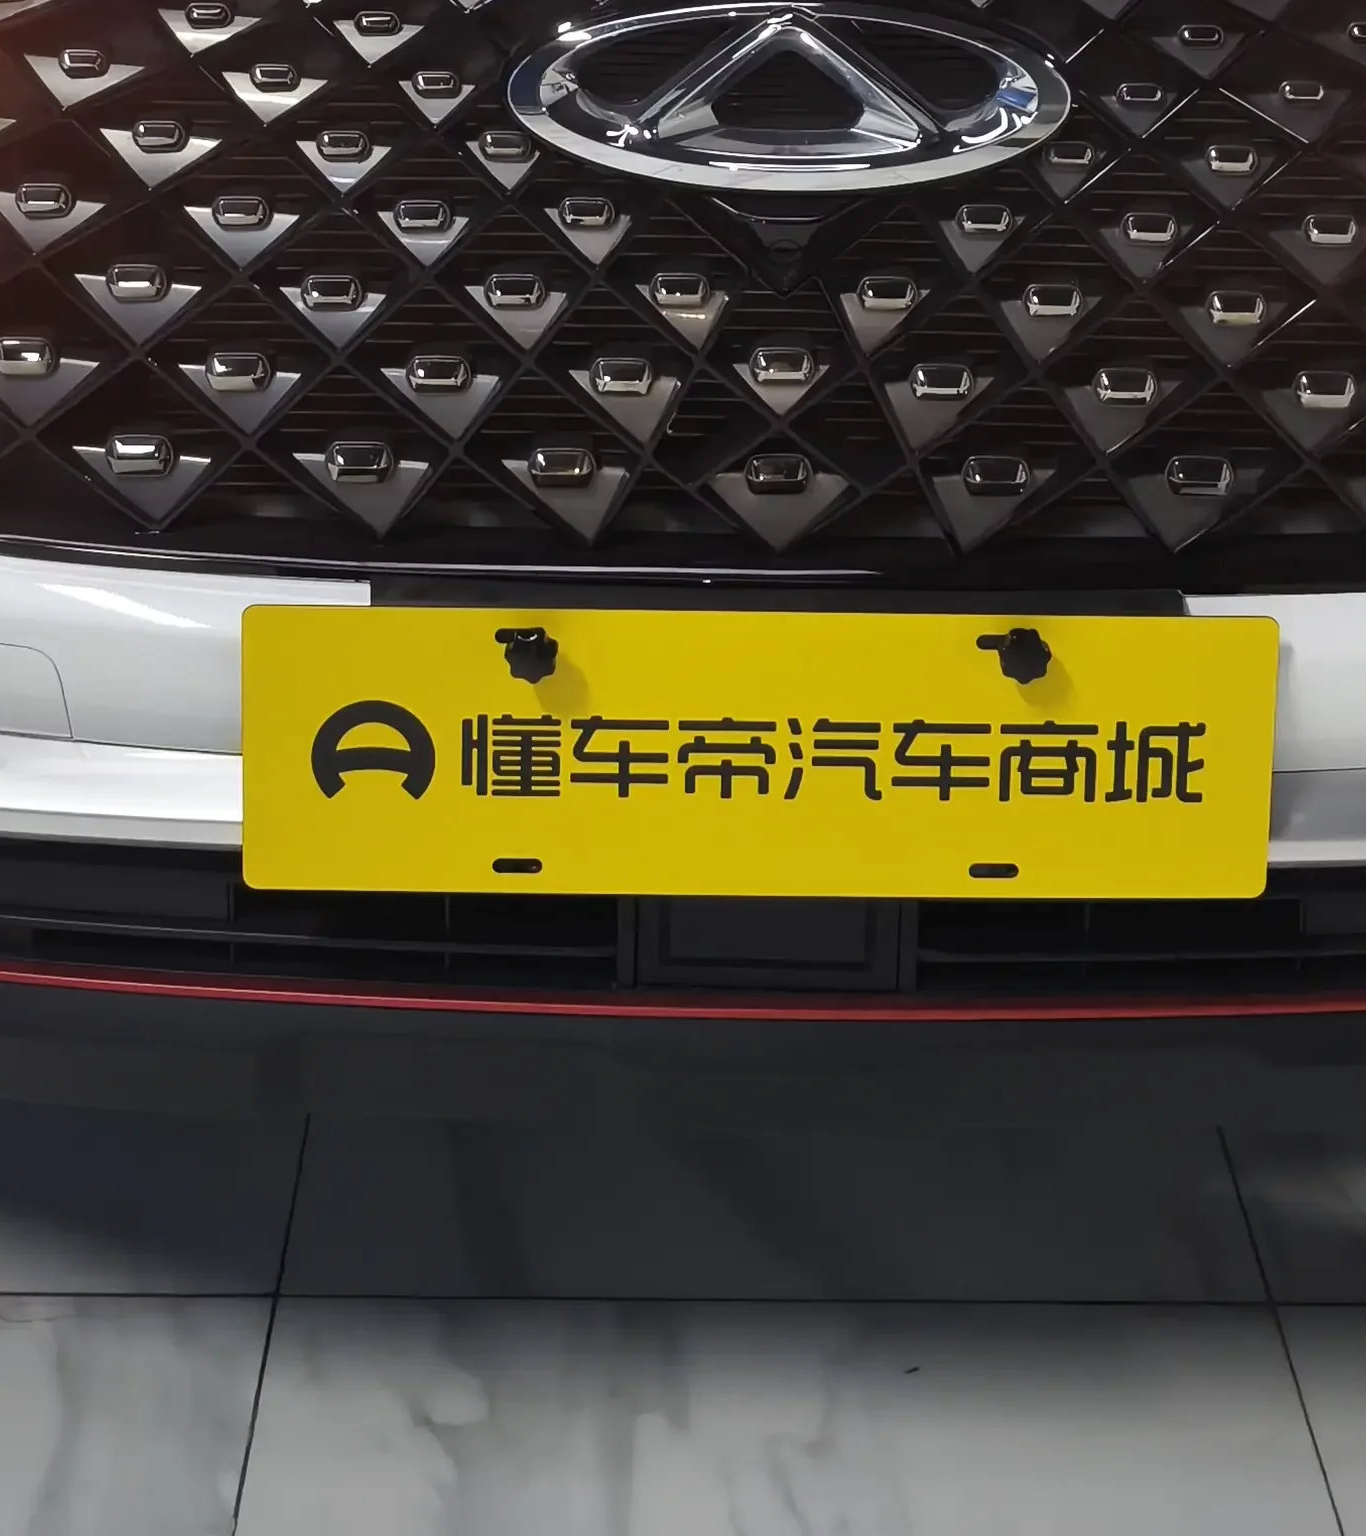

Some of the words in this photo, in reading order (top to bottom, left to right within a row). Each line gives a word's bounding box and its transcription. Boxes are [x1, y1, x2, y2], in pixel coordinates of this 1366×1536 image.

[460, 713, 1207, 804] 懂车帝汽车商城
